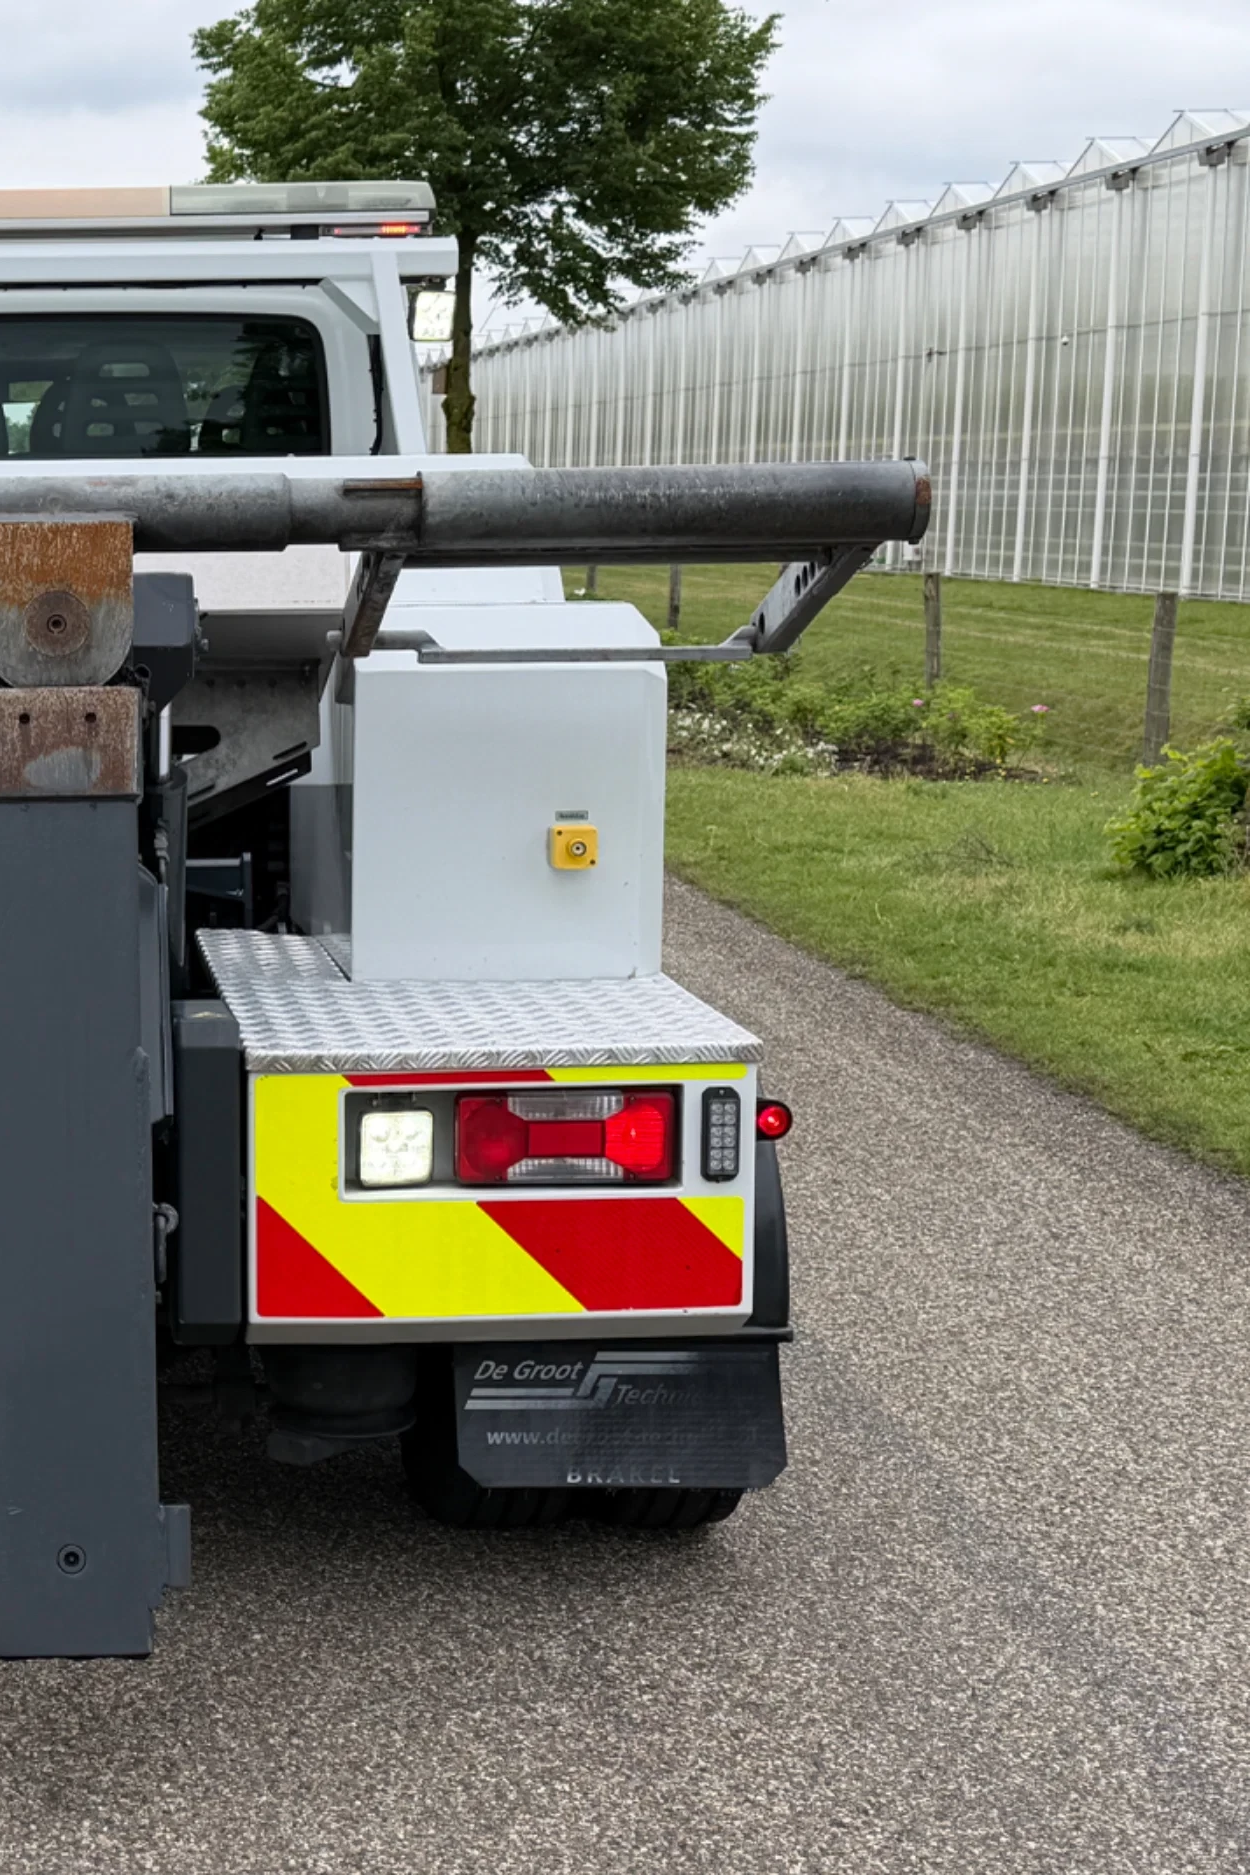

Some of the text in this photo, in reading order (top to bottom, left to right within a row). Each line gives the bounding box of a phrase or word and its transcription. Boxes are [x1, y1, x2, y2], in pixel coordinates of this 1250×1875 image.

[473, 1359, 584, 1381] De Groot
[565, 1464, 682, 1485] BRAKEL
